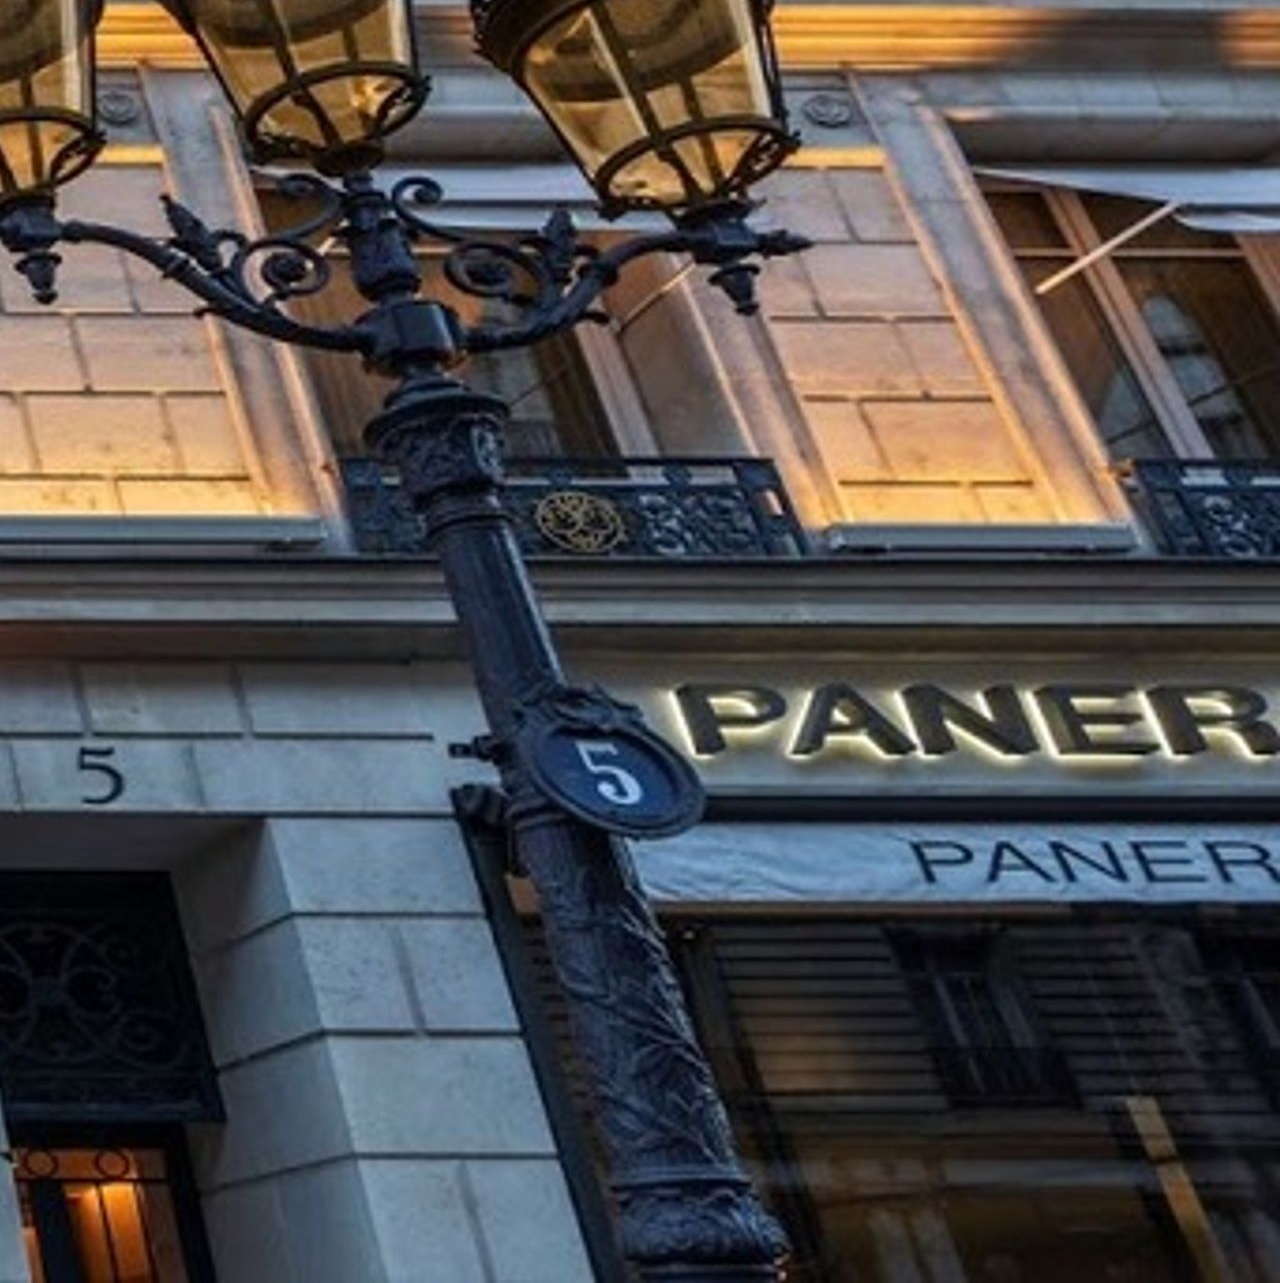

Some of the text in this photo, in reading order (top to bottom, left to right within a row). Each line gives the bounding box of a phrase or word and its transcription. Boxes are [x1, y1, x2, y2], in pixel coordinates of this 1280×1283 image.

[77, 746, 125, 805] 5
[575, 739, 643, 805] 5
[909, 840, 1280, 884] PANER
